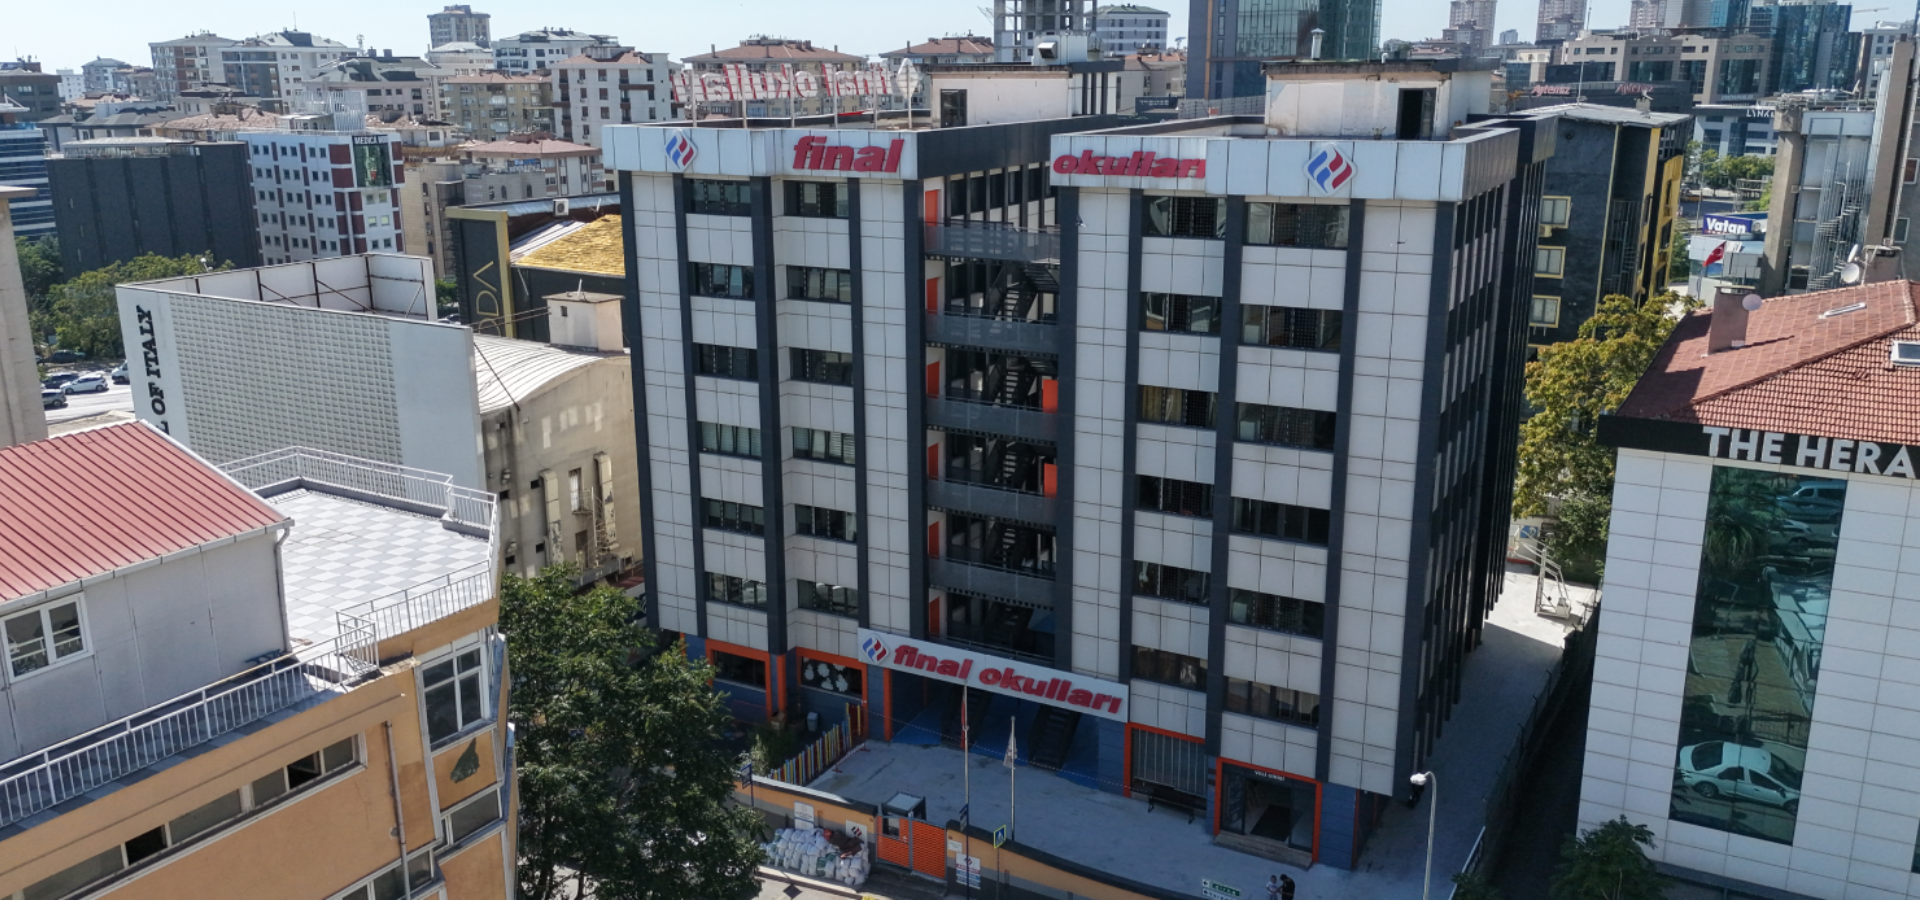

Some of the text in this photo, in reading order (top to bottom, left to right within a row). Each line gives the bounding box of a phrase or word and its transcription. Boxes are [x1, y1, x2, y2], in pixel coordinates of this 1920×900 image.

[792, 135, 905, 173] final
[1053, 150, 1206, 179] okulları
[1706, 217, 1746, 234] Vatan
[136, 305, 161, 379] ITALY
[148, 382, 166, 415] OF
[1703, 426, 1916, 479] THE HERA
[894, 644, 1122, 714] final okulları
